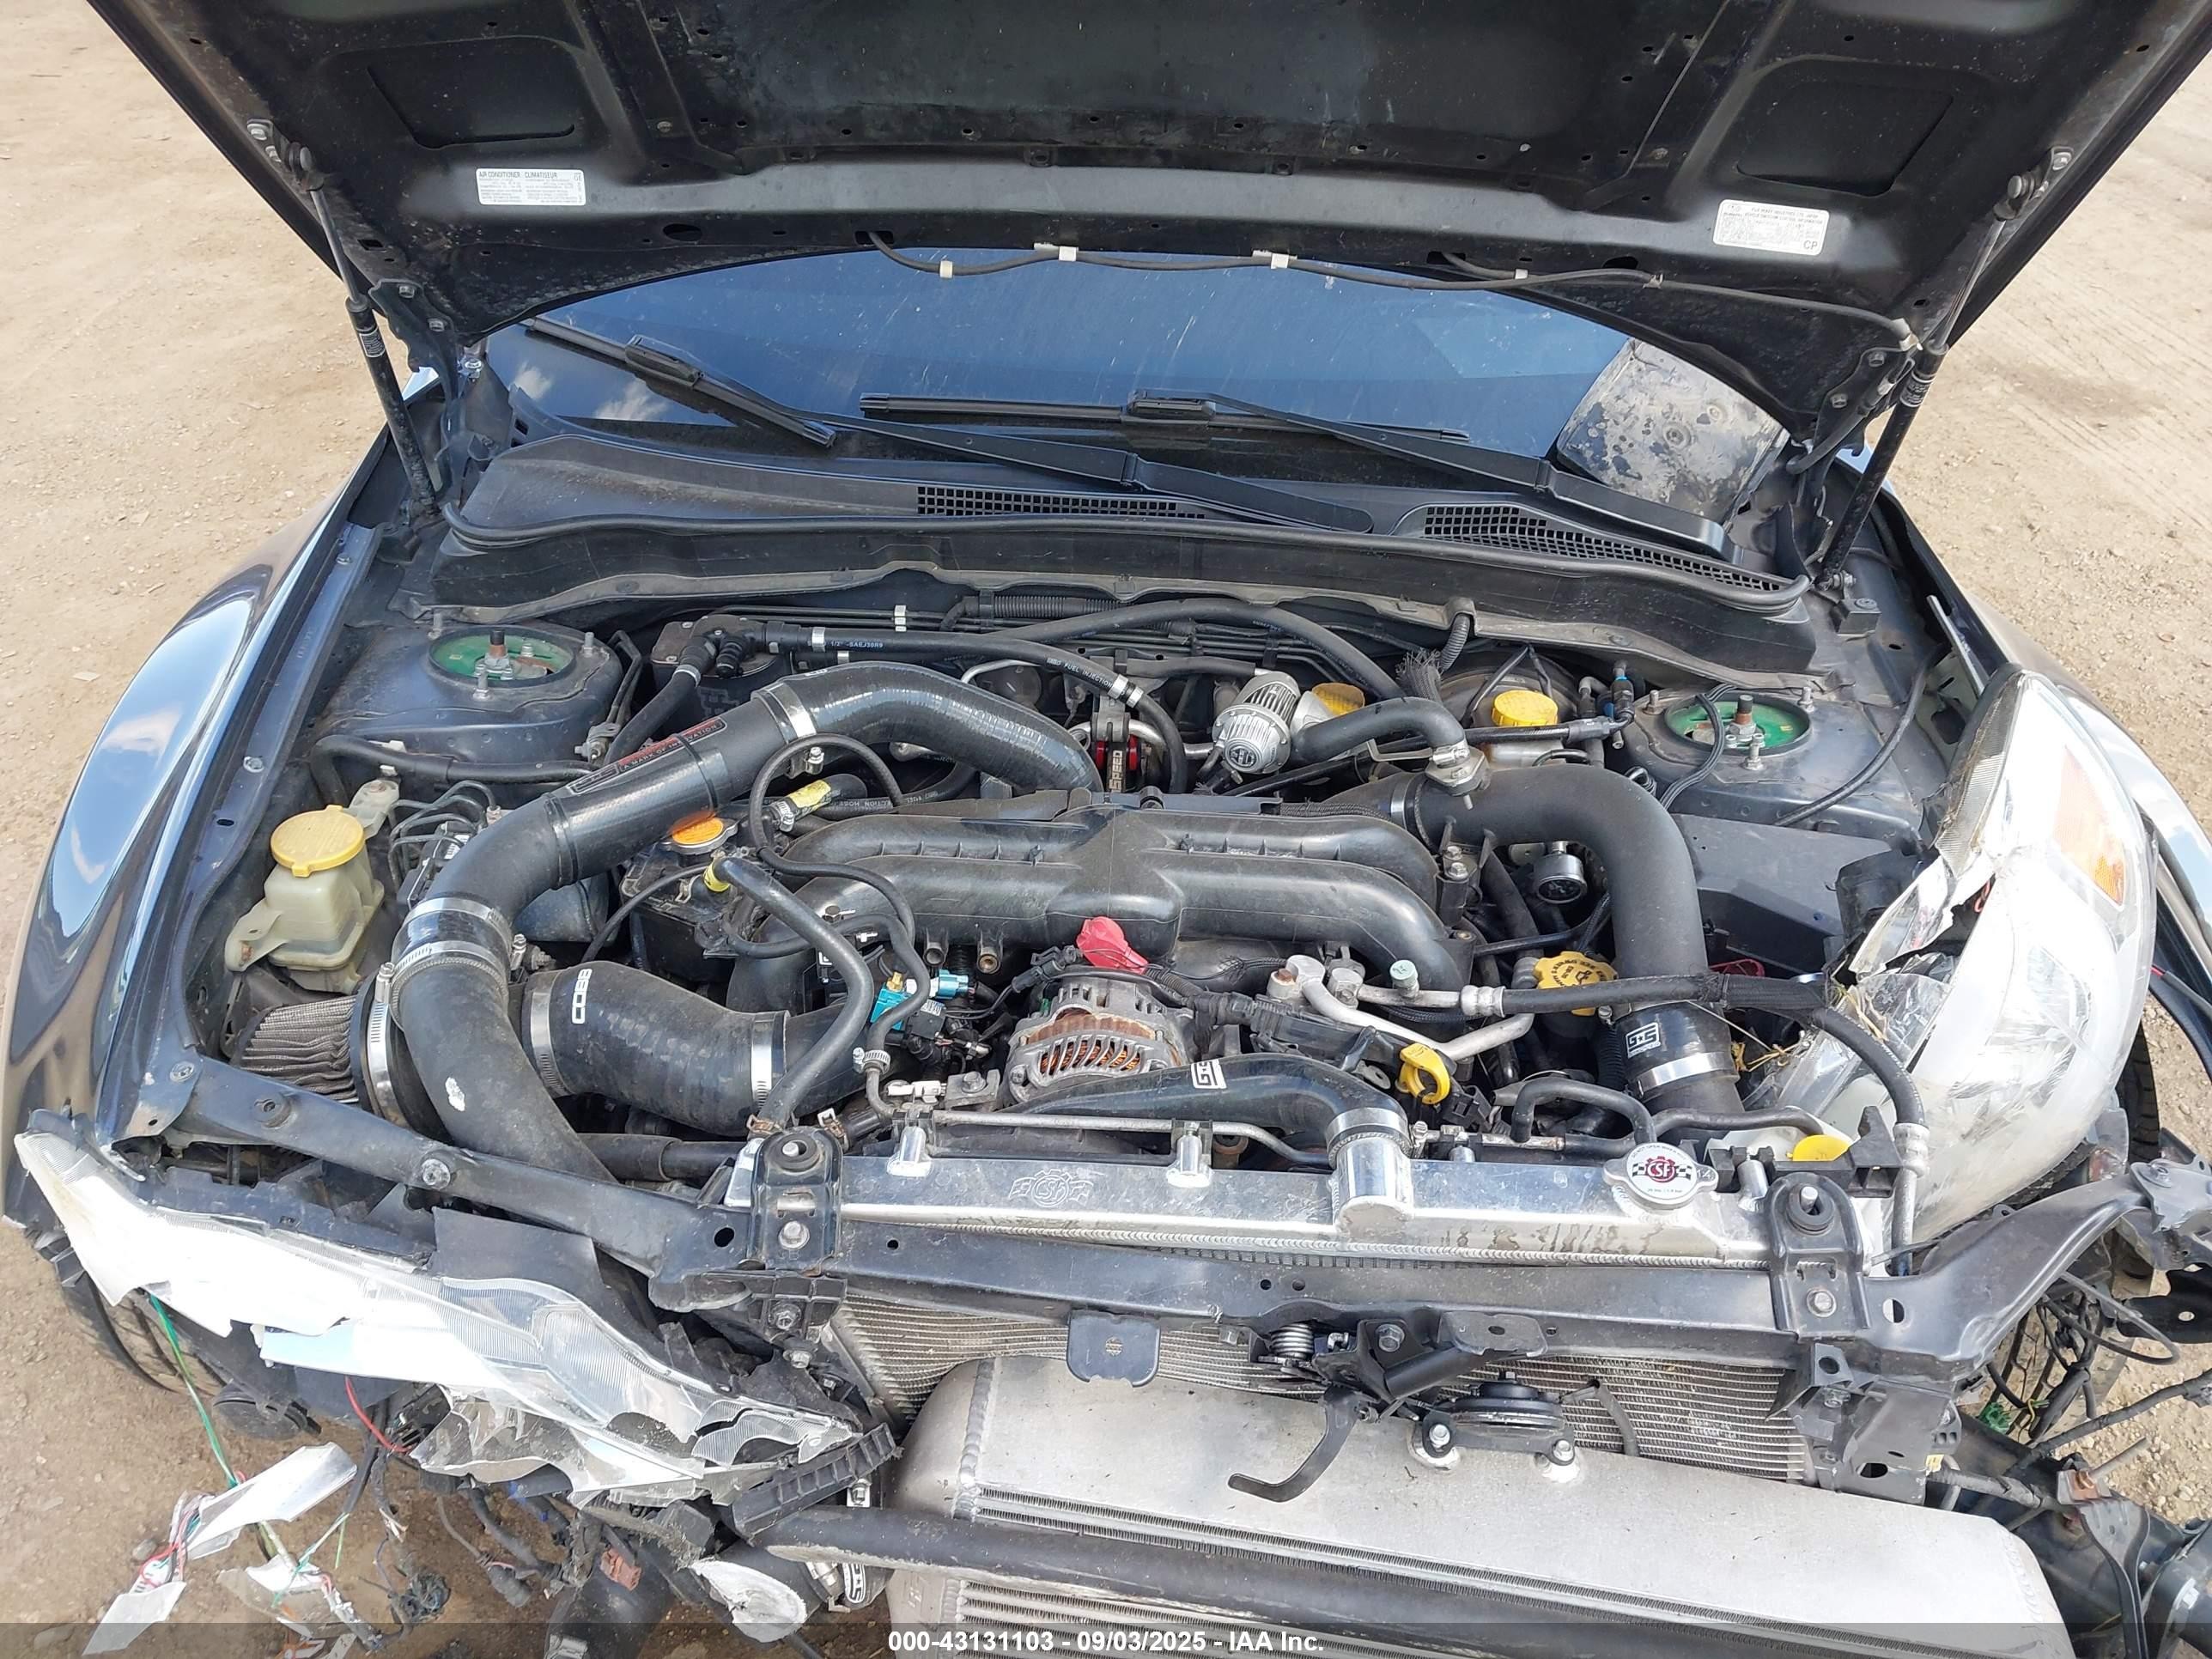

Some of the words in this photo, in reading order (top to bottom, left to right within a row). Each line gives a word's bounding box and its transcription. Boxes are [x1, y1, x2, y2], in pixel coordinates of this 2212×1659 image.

[1803, 240, 1818, 250] CP
[1065, 662, 1079, 673] FUEL
[1082, 670, 1115, 688] INJECTION
[632, 753, 654, 765] MARK
[572, 968, 592, 1024] COBB
[1647, 1163, 1671, 1177] CSF
